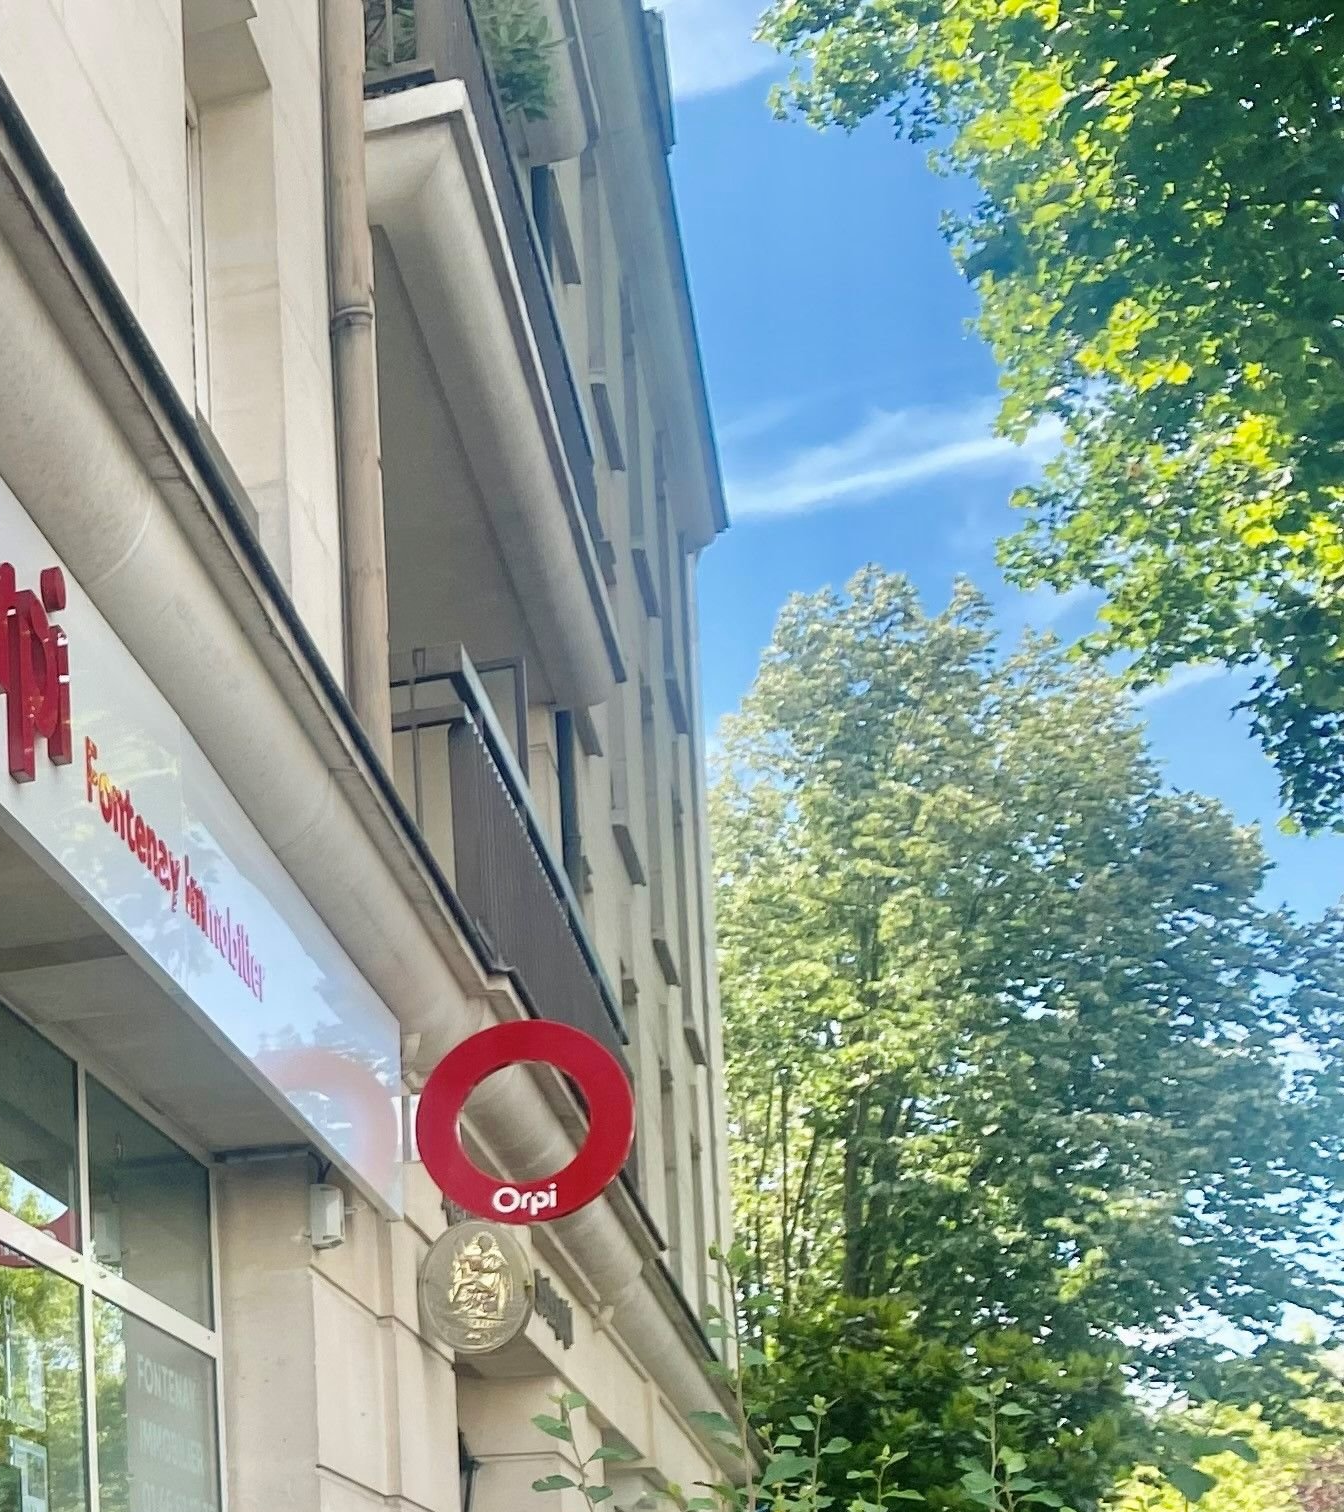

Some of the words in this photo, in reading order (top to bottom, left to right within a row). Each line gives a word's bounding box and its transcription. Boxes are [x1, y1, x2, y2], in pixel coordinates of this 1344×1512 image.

[85, 736, 180, 913] Fontenay
[492, 1183, 557, 1216] Orpi
[137, 1351, 197, 1411] FONTENAY
